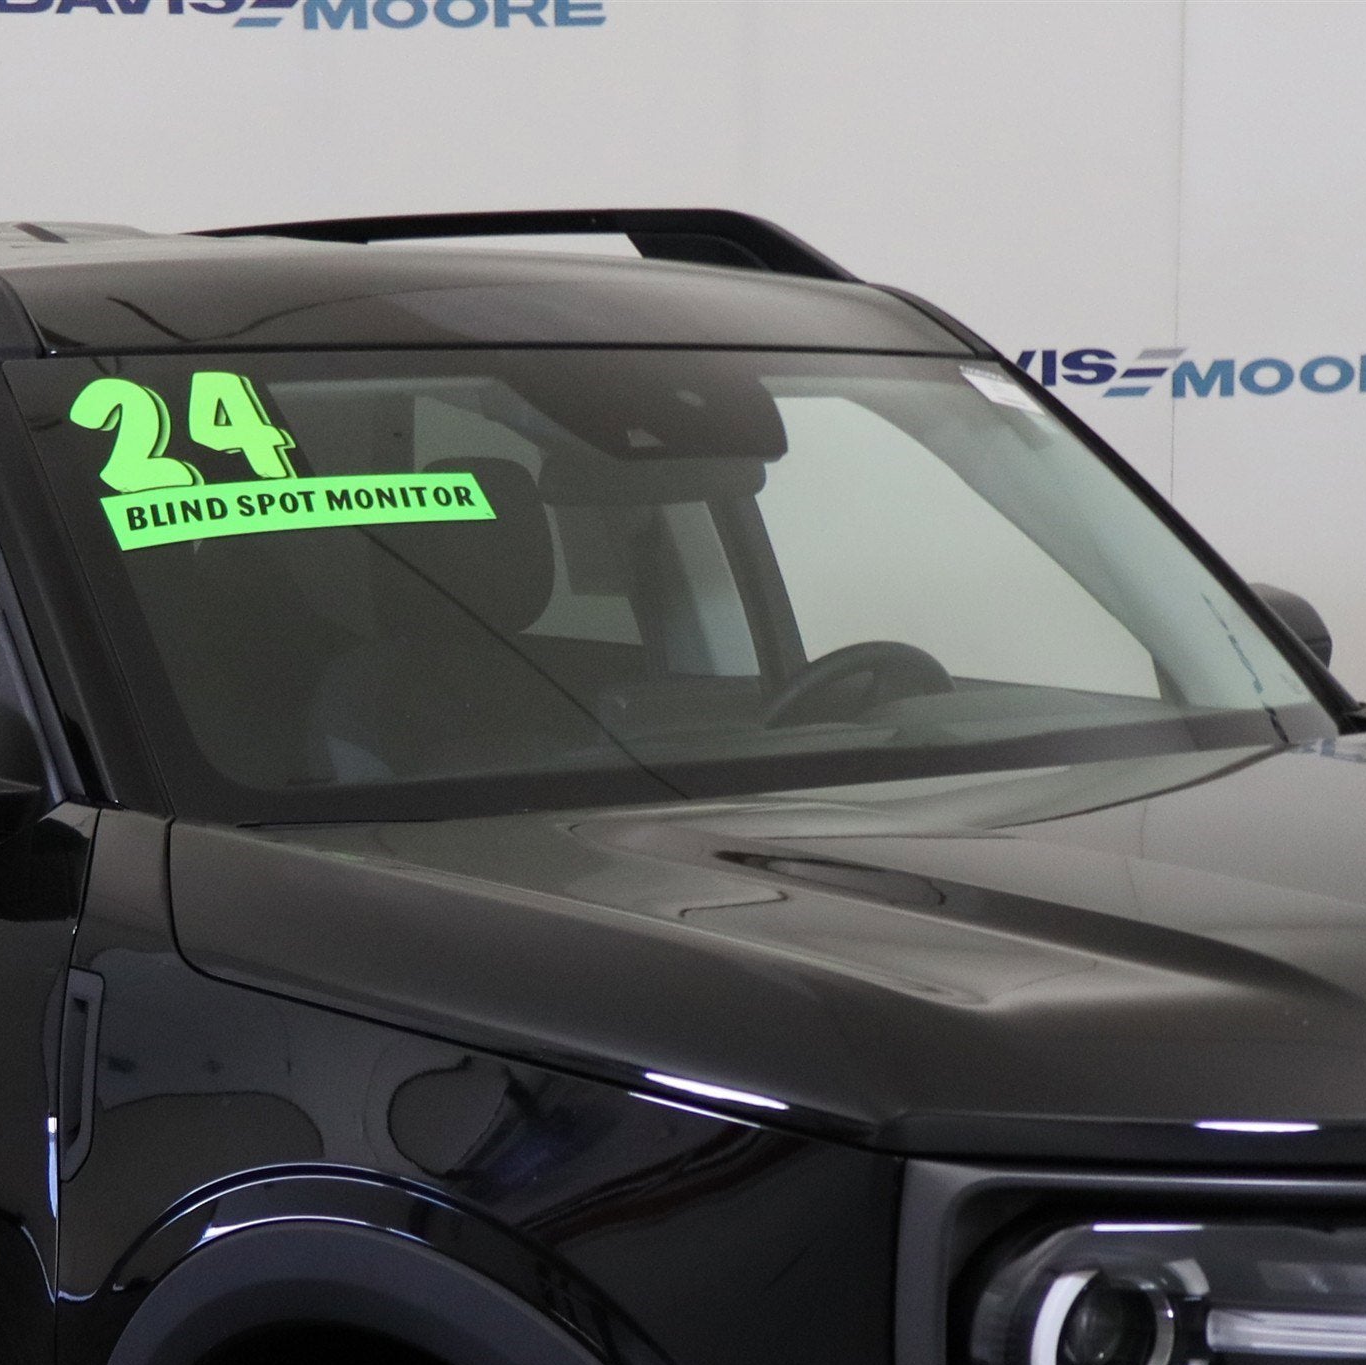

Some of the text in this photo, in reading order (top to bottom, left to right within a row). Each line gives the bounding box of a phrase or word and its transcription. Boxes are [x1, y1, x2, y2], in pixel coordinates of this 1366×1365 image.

[302, 0, 607, 30] MOORE
[70, 371, 297, 493] 24
[125, 486, 477, 532] BLIND SPOT MONITOR
